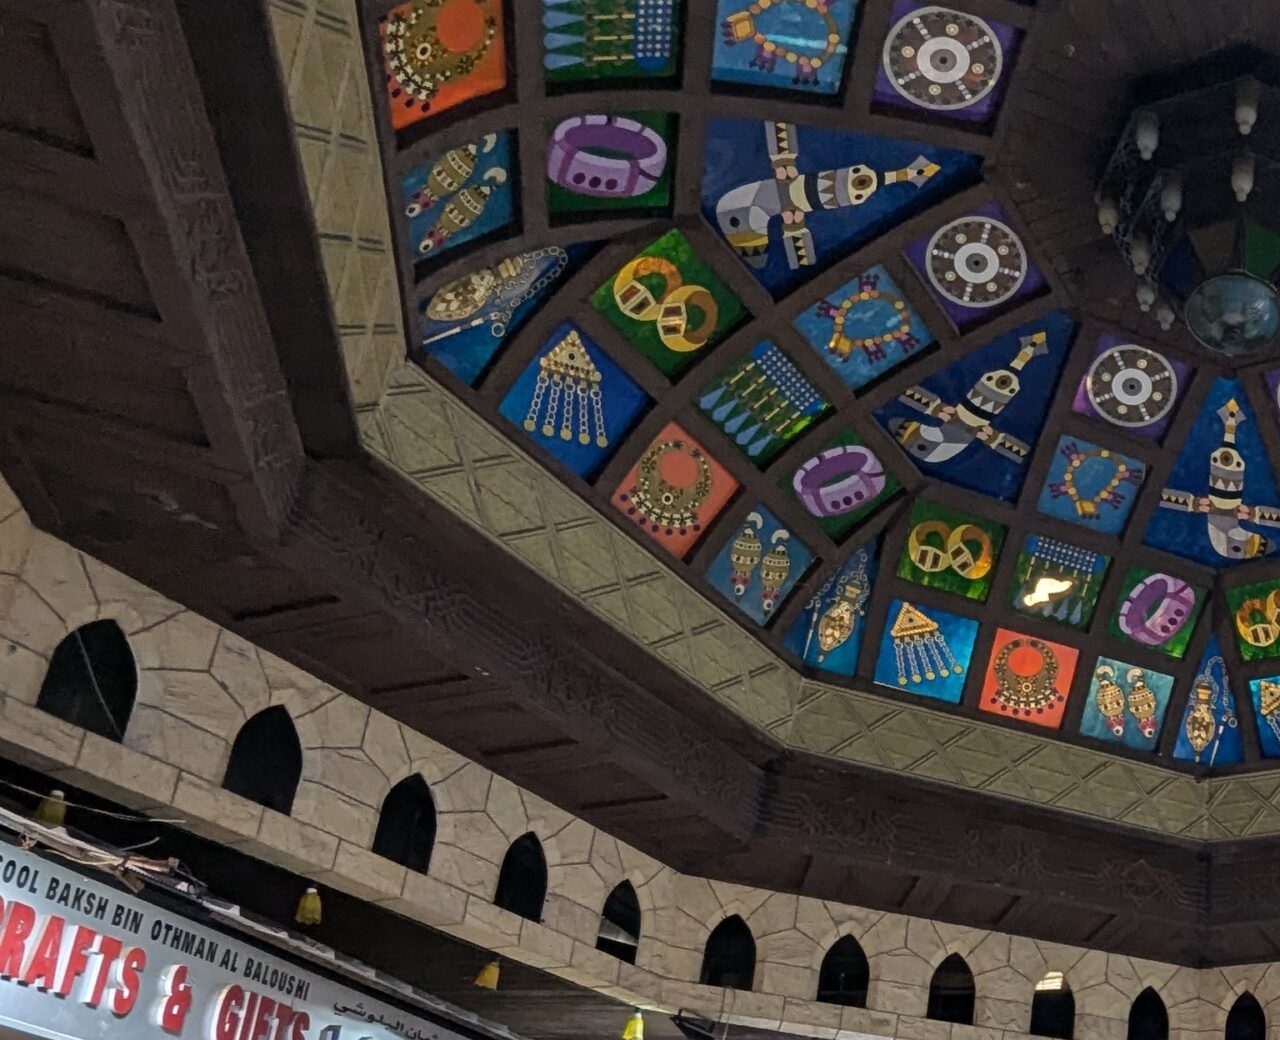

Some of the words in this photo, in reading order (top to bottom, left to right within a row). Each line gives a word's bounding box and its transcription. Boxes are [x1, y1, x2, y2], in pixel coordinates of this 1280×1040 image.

[0, 893, 147, 1018] RAFTS
[158, 963, 193, 1036] &
[45, 877, 108, 921] BAKSH
[112, 904, 145, 935] BIN
[151, 919, 217, 964] OTHMAN
[219, 949, 239, 973] AL
[243, 957, 311, 1002] BALOUSHI
[333, 1000, 405, 1034] البلوشي
